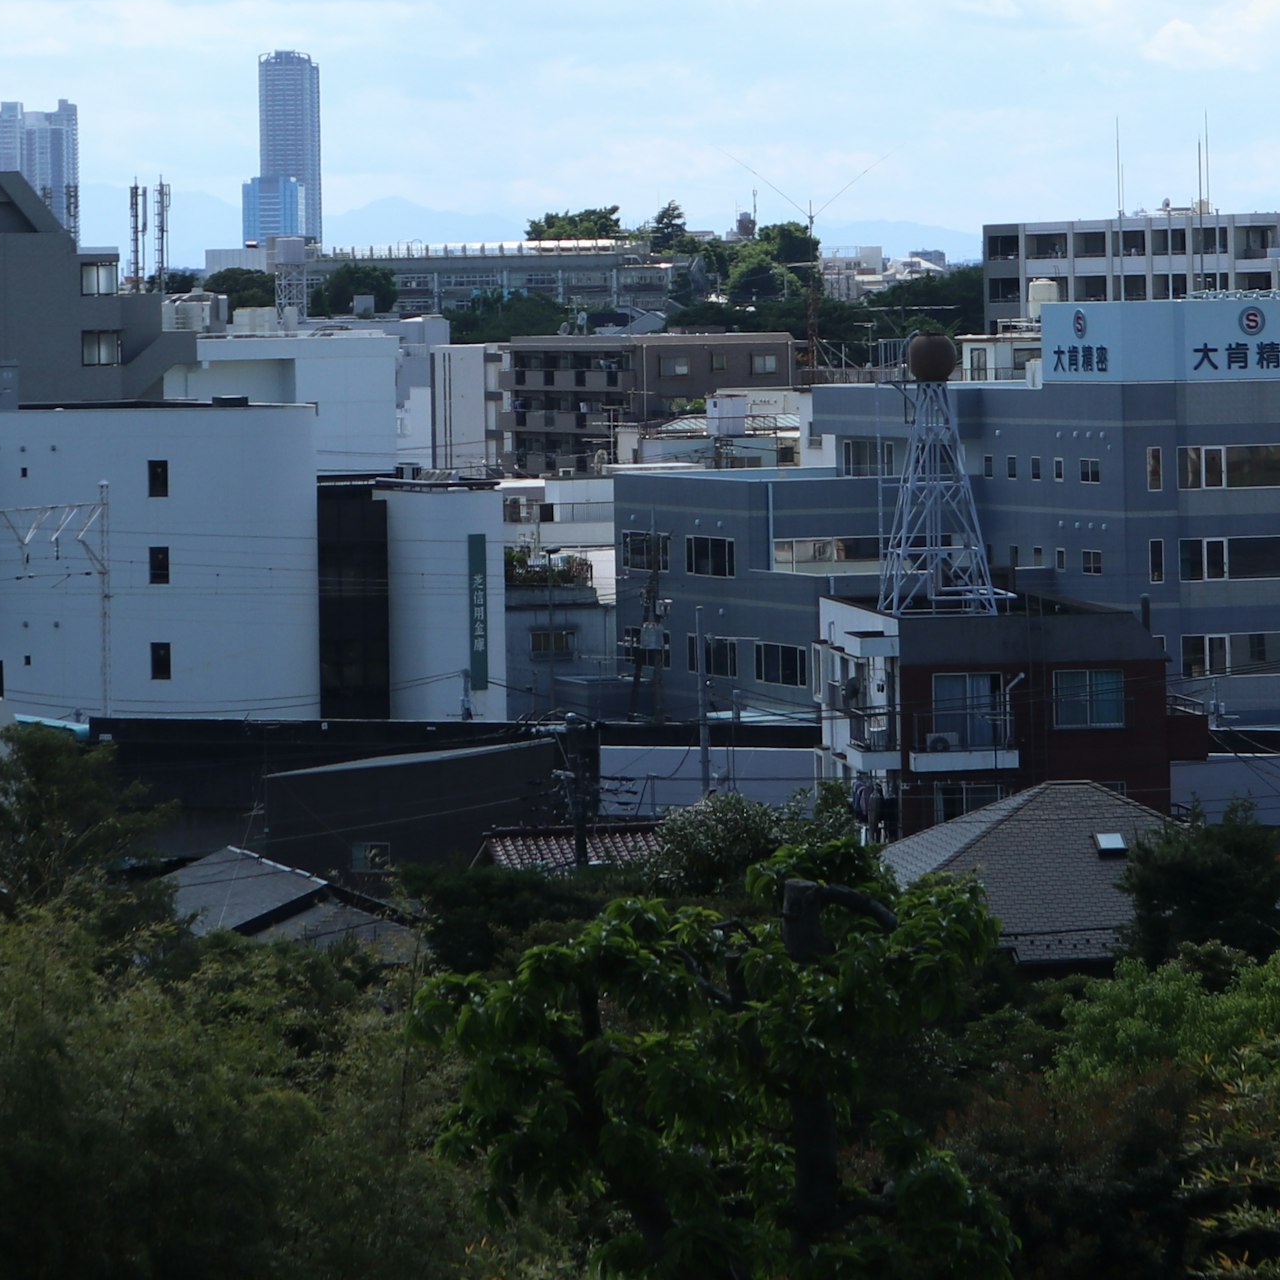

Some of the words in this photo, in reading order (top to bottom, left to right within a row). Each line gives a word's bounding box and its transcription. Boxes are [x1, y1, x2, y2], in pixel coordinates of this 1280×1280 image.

[1053, 344, 1109, 373] 大肯精密
[472, 573, 485, 652] 芝信用金庫
